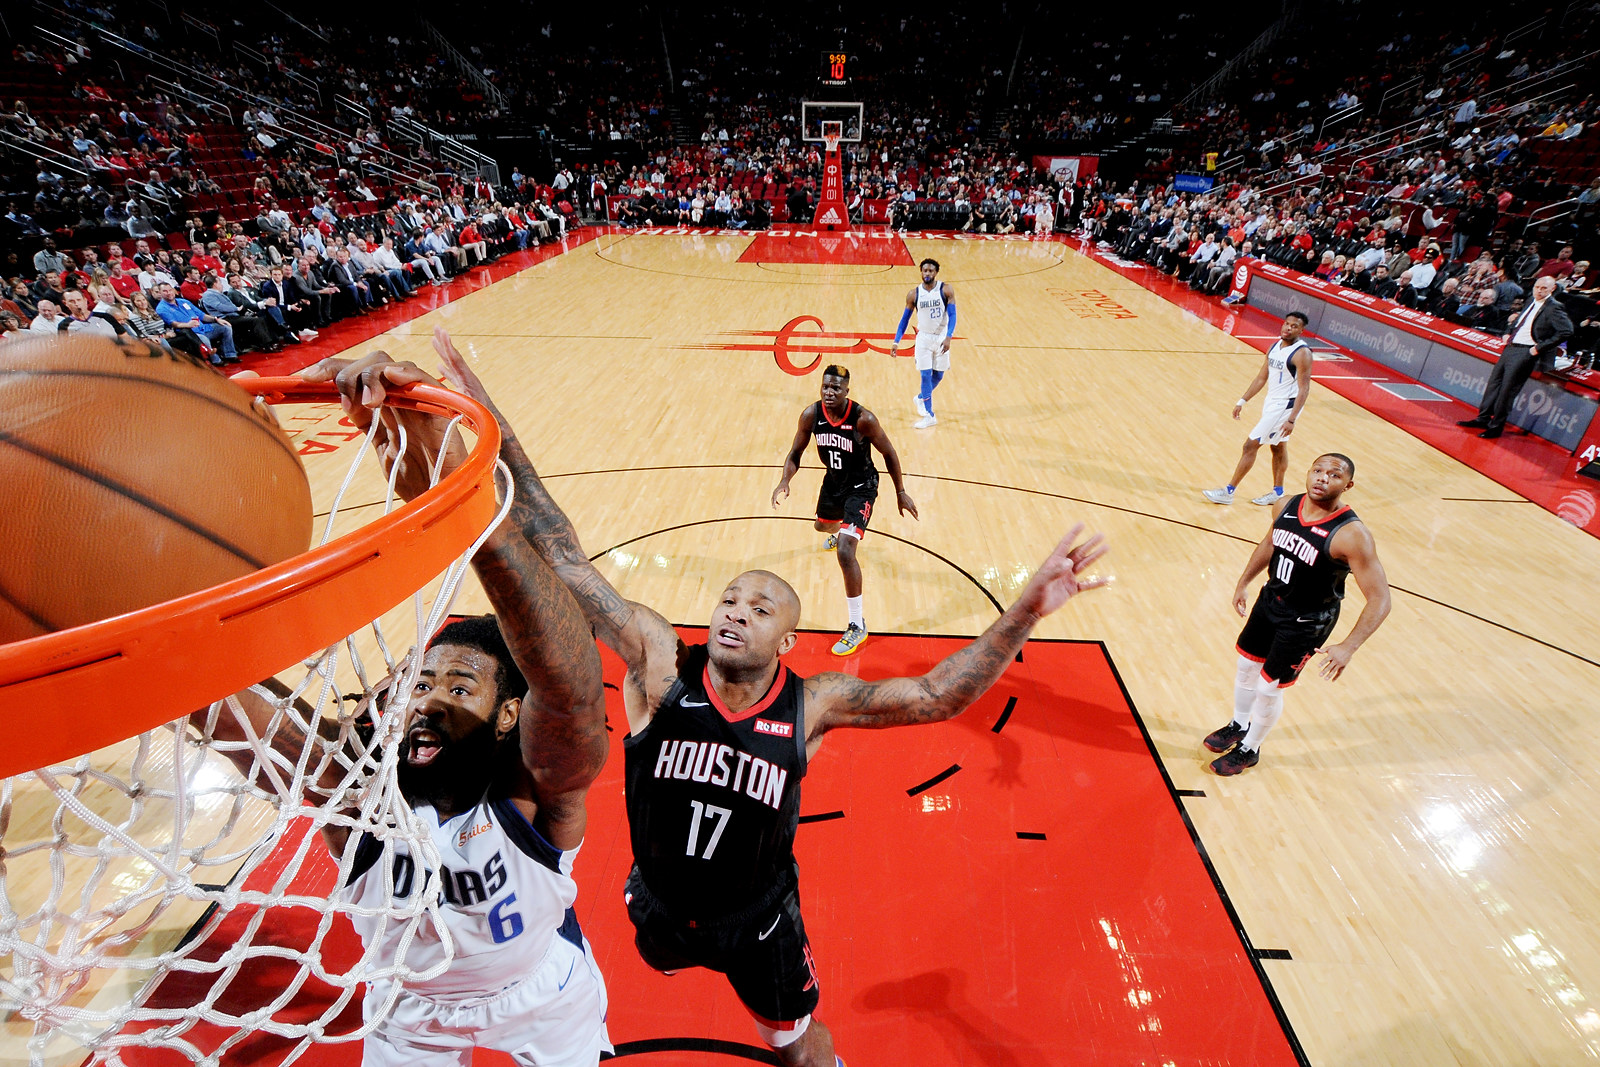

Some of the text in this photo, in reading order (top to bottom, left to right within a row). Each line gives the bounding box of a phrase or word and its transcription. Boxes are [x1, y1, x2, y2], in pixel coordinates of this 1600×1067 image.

[829, 54, 846, 64] 9:59
[831, 63, 844, 79] 10
[634, 228, 818, 238] HOUSTON
[920, 299, 940, 308] DALLAS
[930, 307, 942, 318] 23
[1076, 289, 1138, 319] TOYOTA
[1329, 319, 1414, 364] apartment list
[1279, 371, 1283, 384] 1
[1546, 405, 1579, 433] list
[815, 433, 853, 453] HOUSTON
[828, 450, 842, 470] 15
[1272, 528, 1319, 567] HOUSTON
[1276, 554, 1294, 585] 10
[653, 739, 788, 811] HOUSTON
[685, 799, 732, 861] 17
[487, 891, 524, 944] 6
